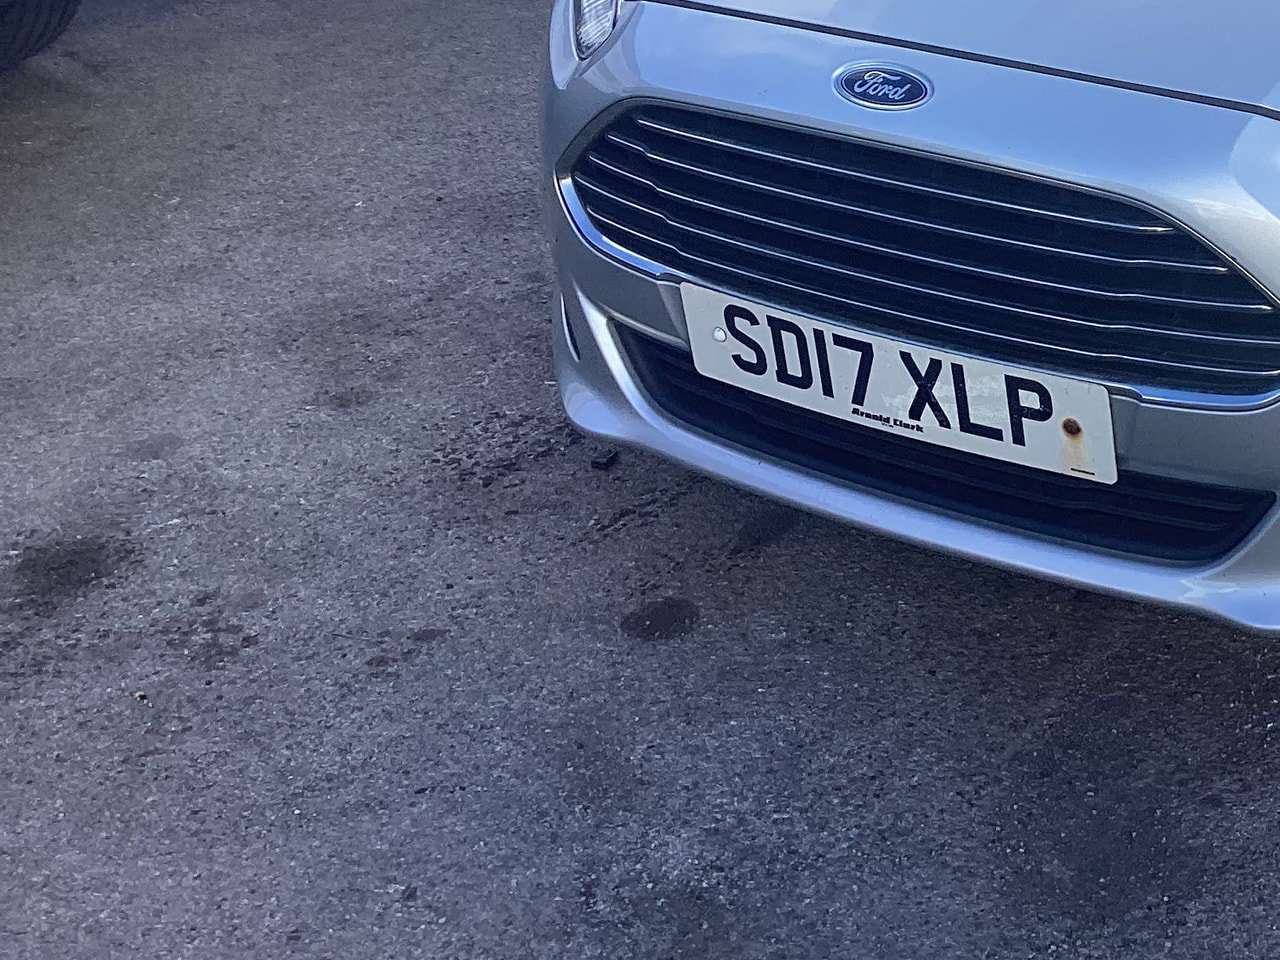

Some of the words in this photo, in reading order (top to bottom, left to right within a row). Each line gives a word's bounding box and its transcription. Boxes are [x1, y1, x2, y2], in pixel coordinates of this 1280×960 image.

[853, 70, 911, 100] Ford
[723, 304, 874, 408] SD17
[899, 350, 1054, 447] XLP
[851, 407, 891, 424] Arnold
